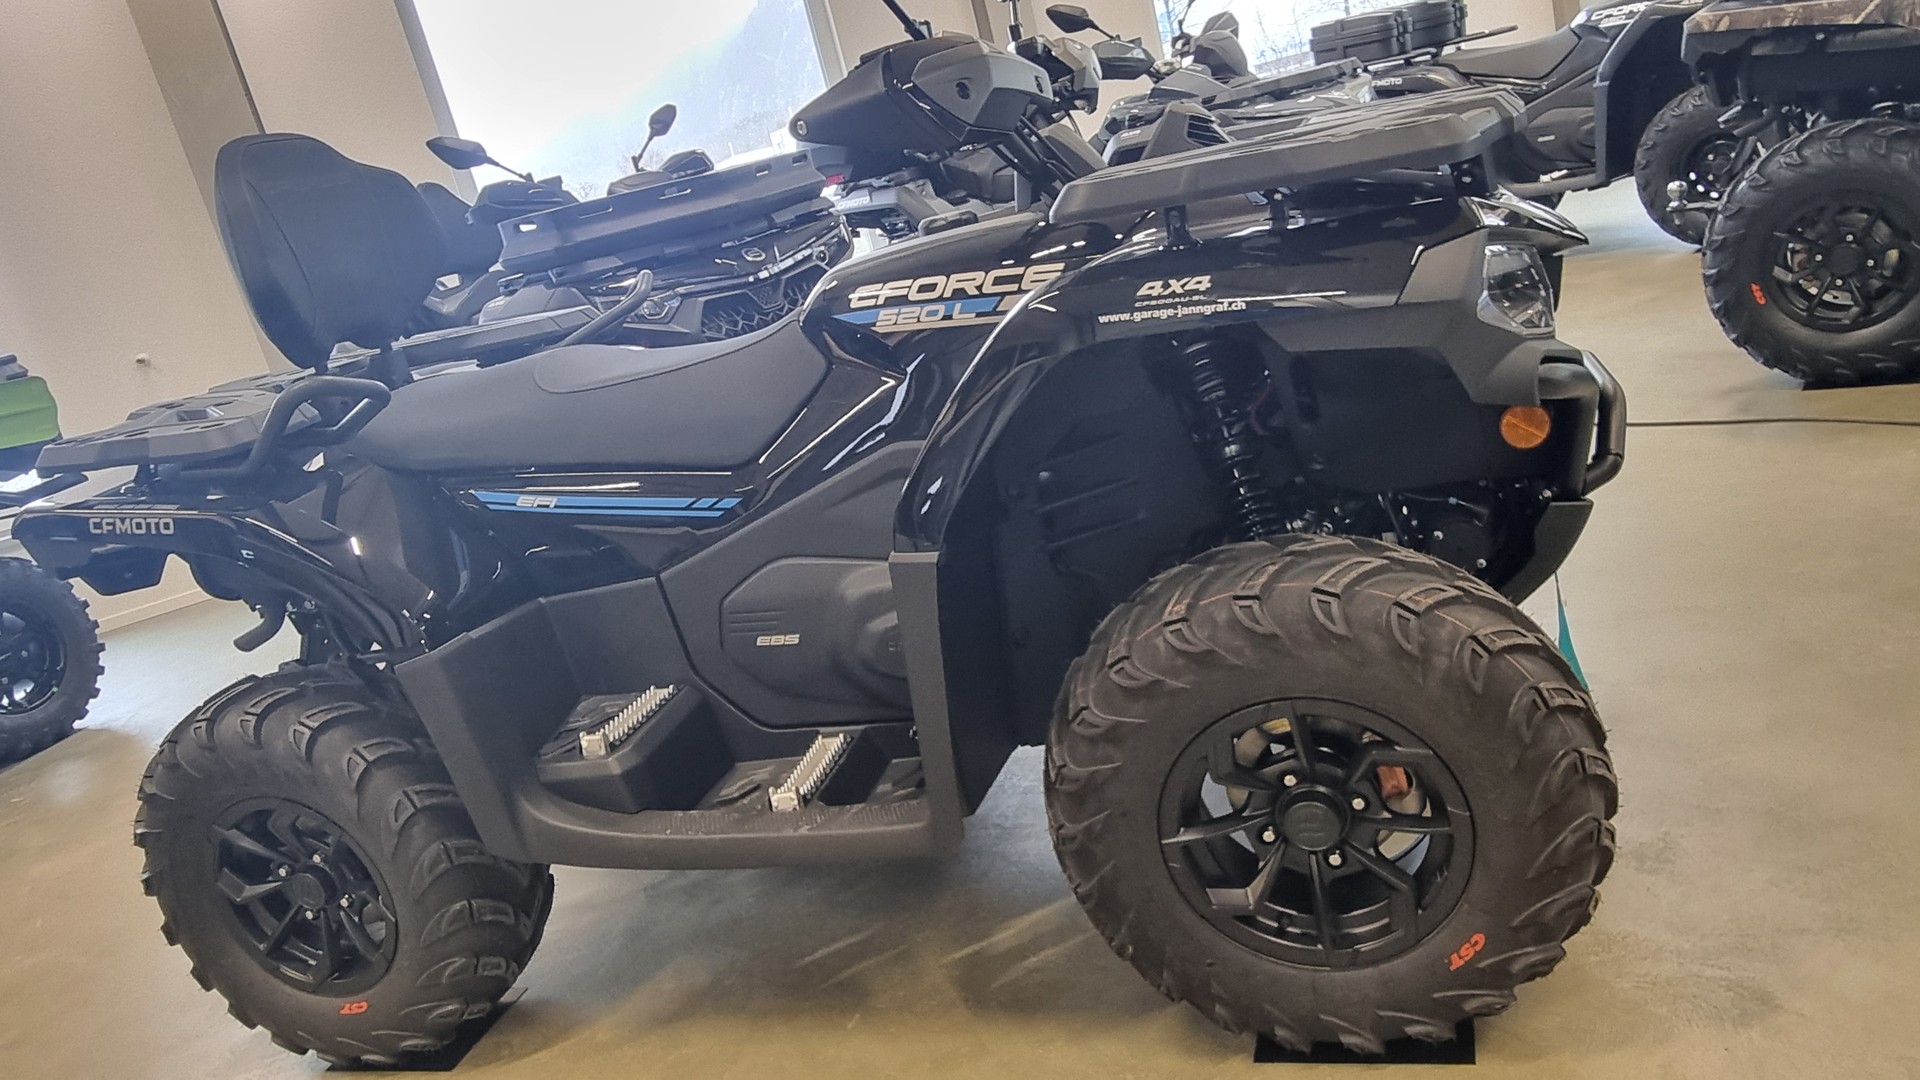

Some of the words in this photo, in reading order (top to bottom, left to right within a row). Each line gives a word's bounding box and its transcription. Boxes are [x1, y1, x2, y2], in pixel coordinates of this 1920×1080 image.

[1371, 77, 1403, 87] FMOTO
[849, 262, 1066, 309] CFORCE
[875, 304, 946, 328] 520
[952, 303, 977, 320] L
[1098, 300, 1247, 324] www.garage-janngraf.ch
[516, 496, 558, 509] EFI
[89, 517, 175, 535] CFMOTO
[1449, 932, 1487, 972] CST
[338, 1000, 369, 1016] CST
